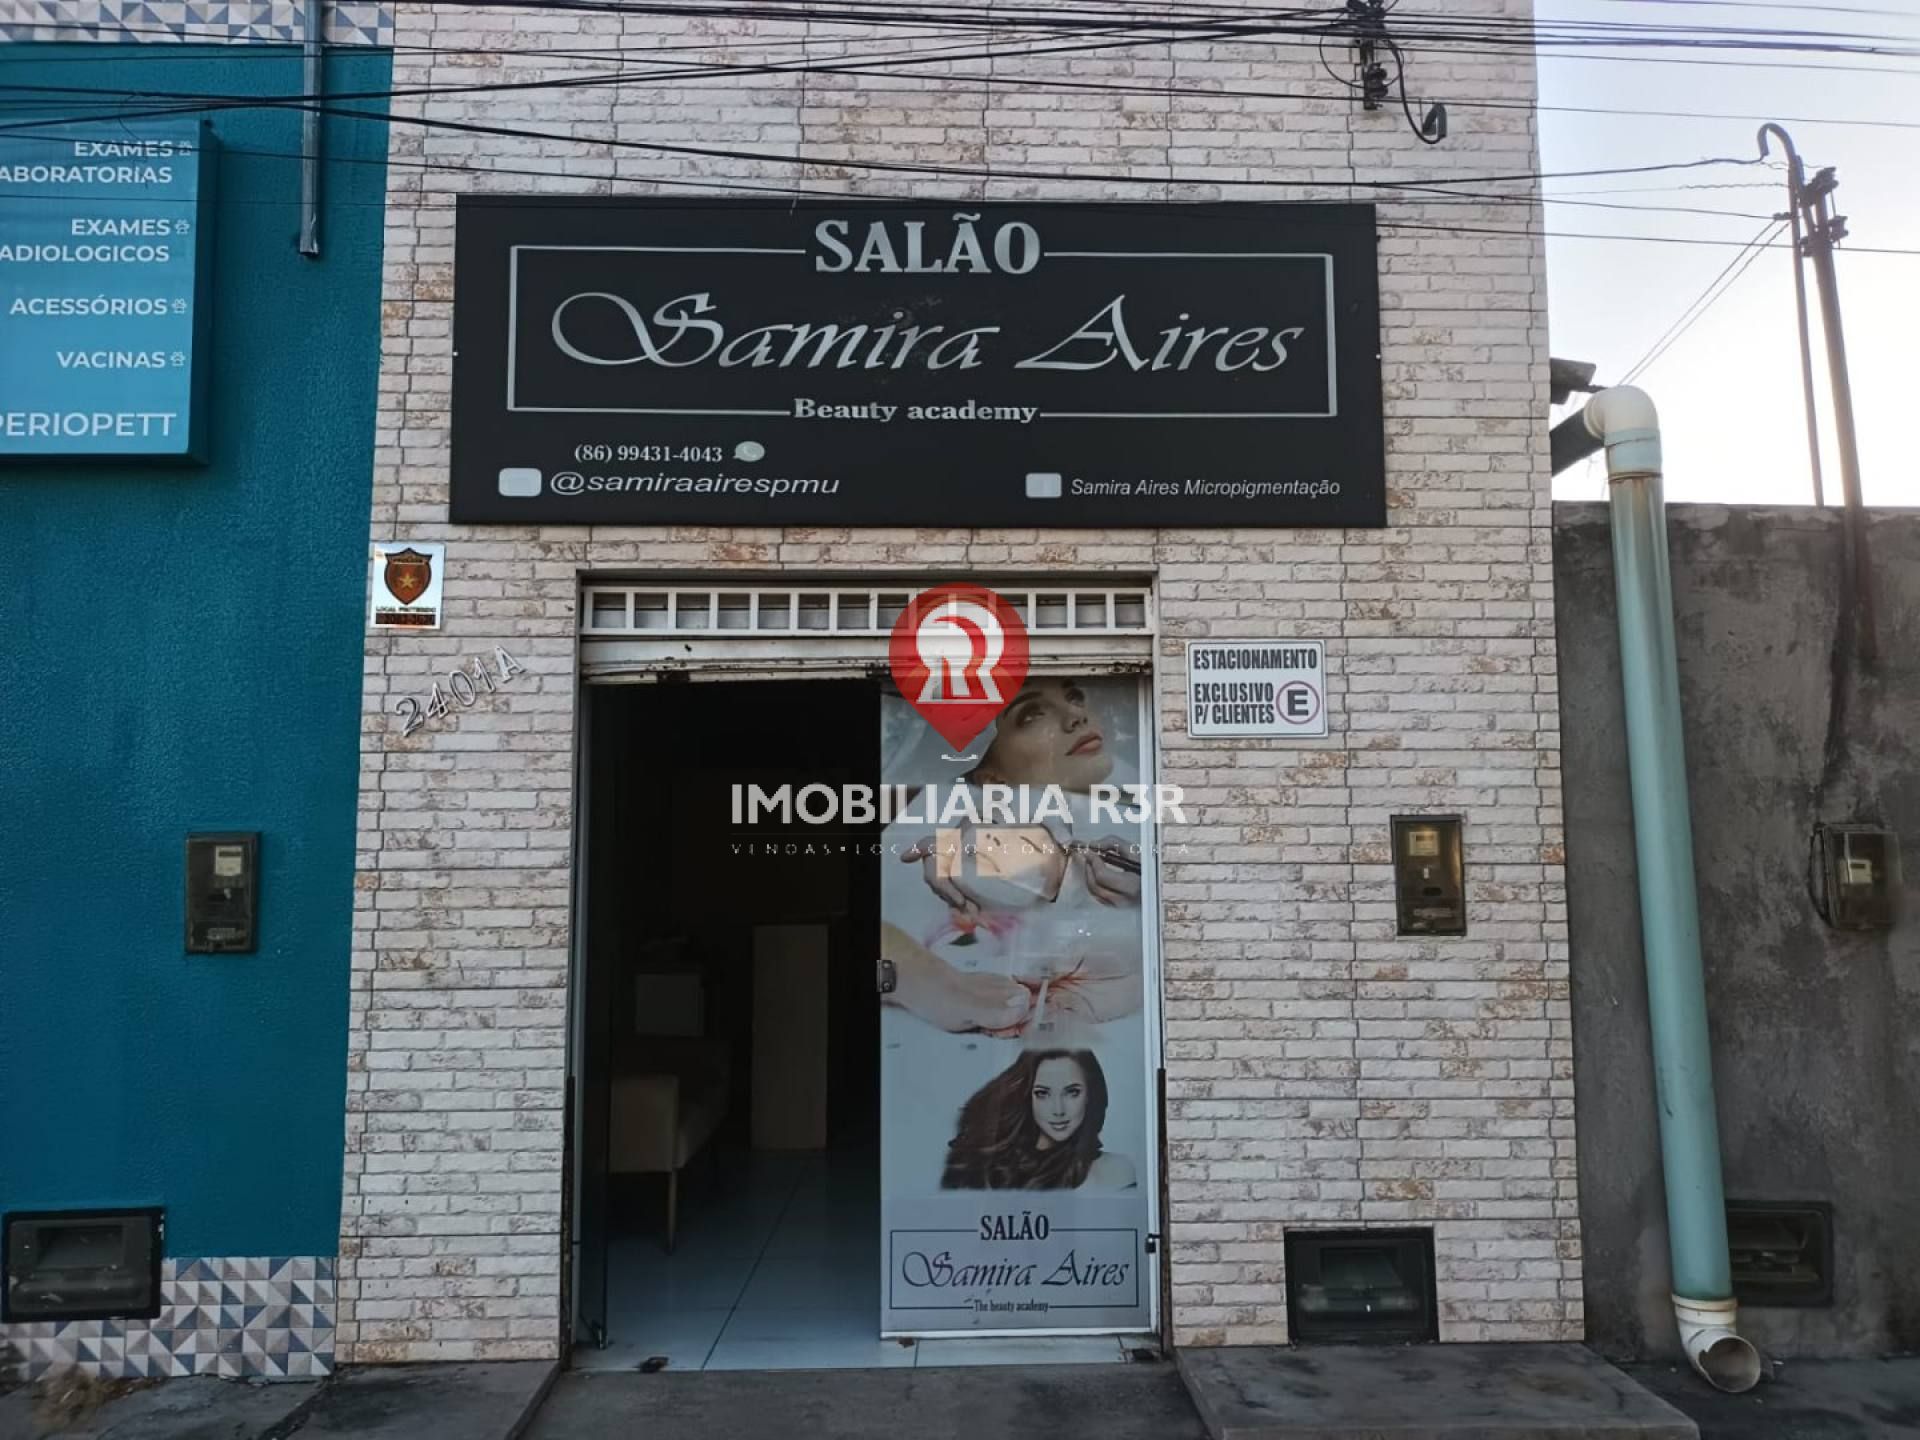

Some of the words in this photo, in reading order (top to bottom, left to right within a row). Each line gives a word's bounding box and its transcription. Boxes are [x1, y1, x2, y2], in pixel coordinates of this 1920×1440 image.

[74, 140, 174, 157] EXAMES
[71, 218, 171, 236] EXAMES
[814, 213, 1041, 275] SALÃO
[9, 295, 168, 315] ACESSÓRIOS
[551, 291, 1001, 371] Samira
[1014, 293, 1306, 373] Aires
[57, 351, 166, 369] VACINAS
[793, 398, 898, 423] Beauty
[907, 400, 1038, 424] academy
[0, 412, 178, 437] ERIOPETT
[574, 444, 613, 464] (86)
[617, 445, 723, 463] 99431-4043
[550, 470, 840, 499] @samiraairespmu
[1070, 478, 1132, 496] Samira
[1134, 479, 1180, 496] Aires
[1184, 479, 1342, 499] Micropigmentação
[1193, 648, 1318, 670] ESTACIONAMENTO
[395, 646, 528, 738] 2401A
[1194, 683, 1275, 703] EXCLUSIVO
[1195, 703, 1209, 725] P/
[1211, 703, 1276, 725] CLIENTES
[980, 1211, 1050, 1241] SALÃO
[902, 1250, 1038, 1288] Samira
[1041, 1249, 1130, 1287] Aires
[974, 1299, 989, 1312] The
